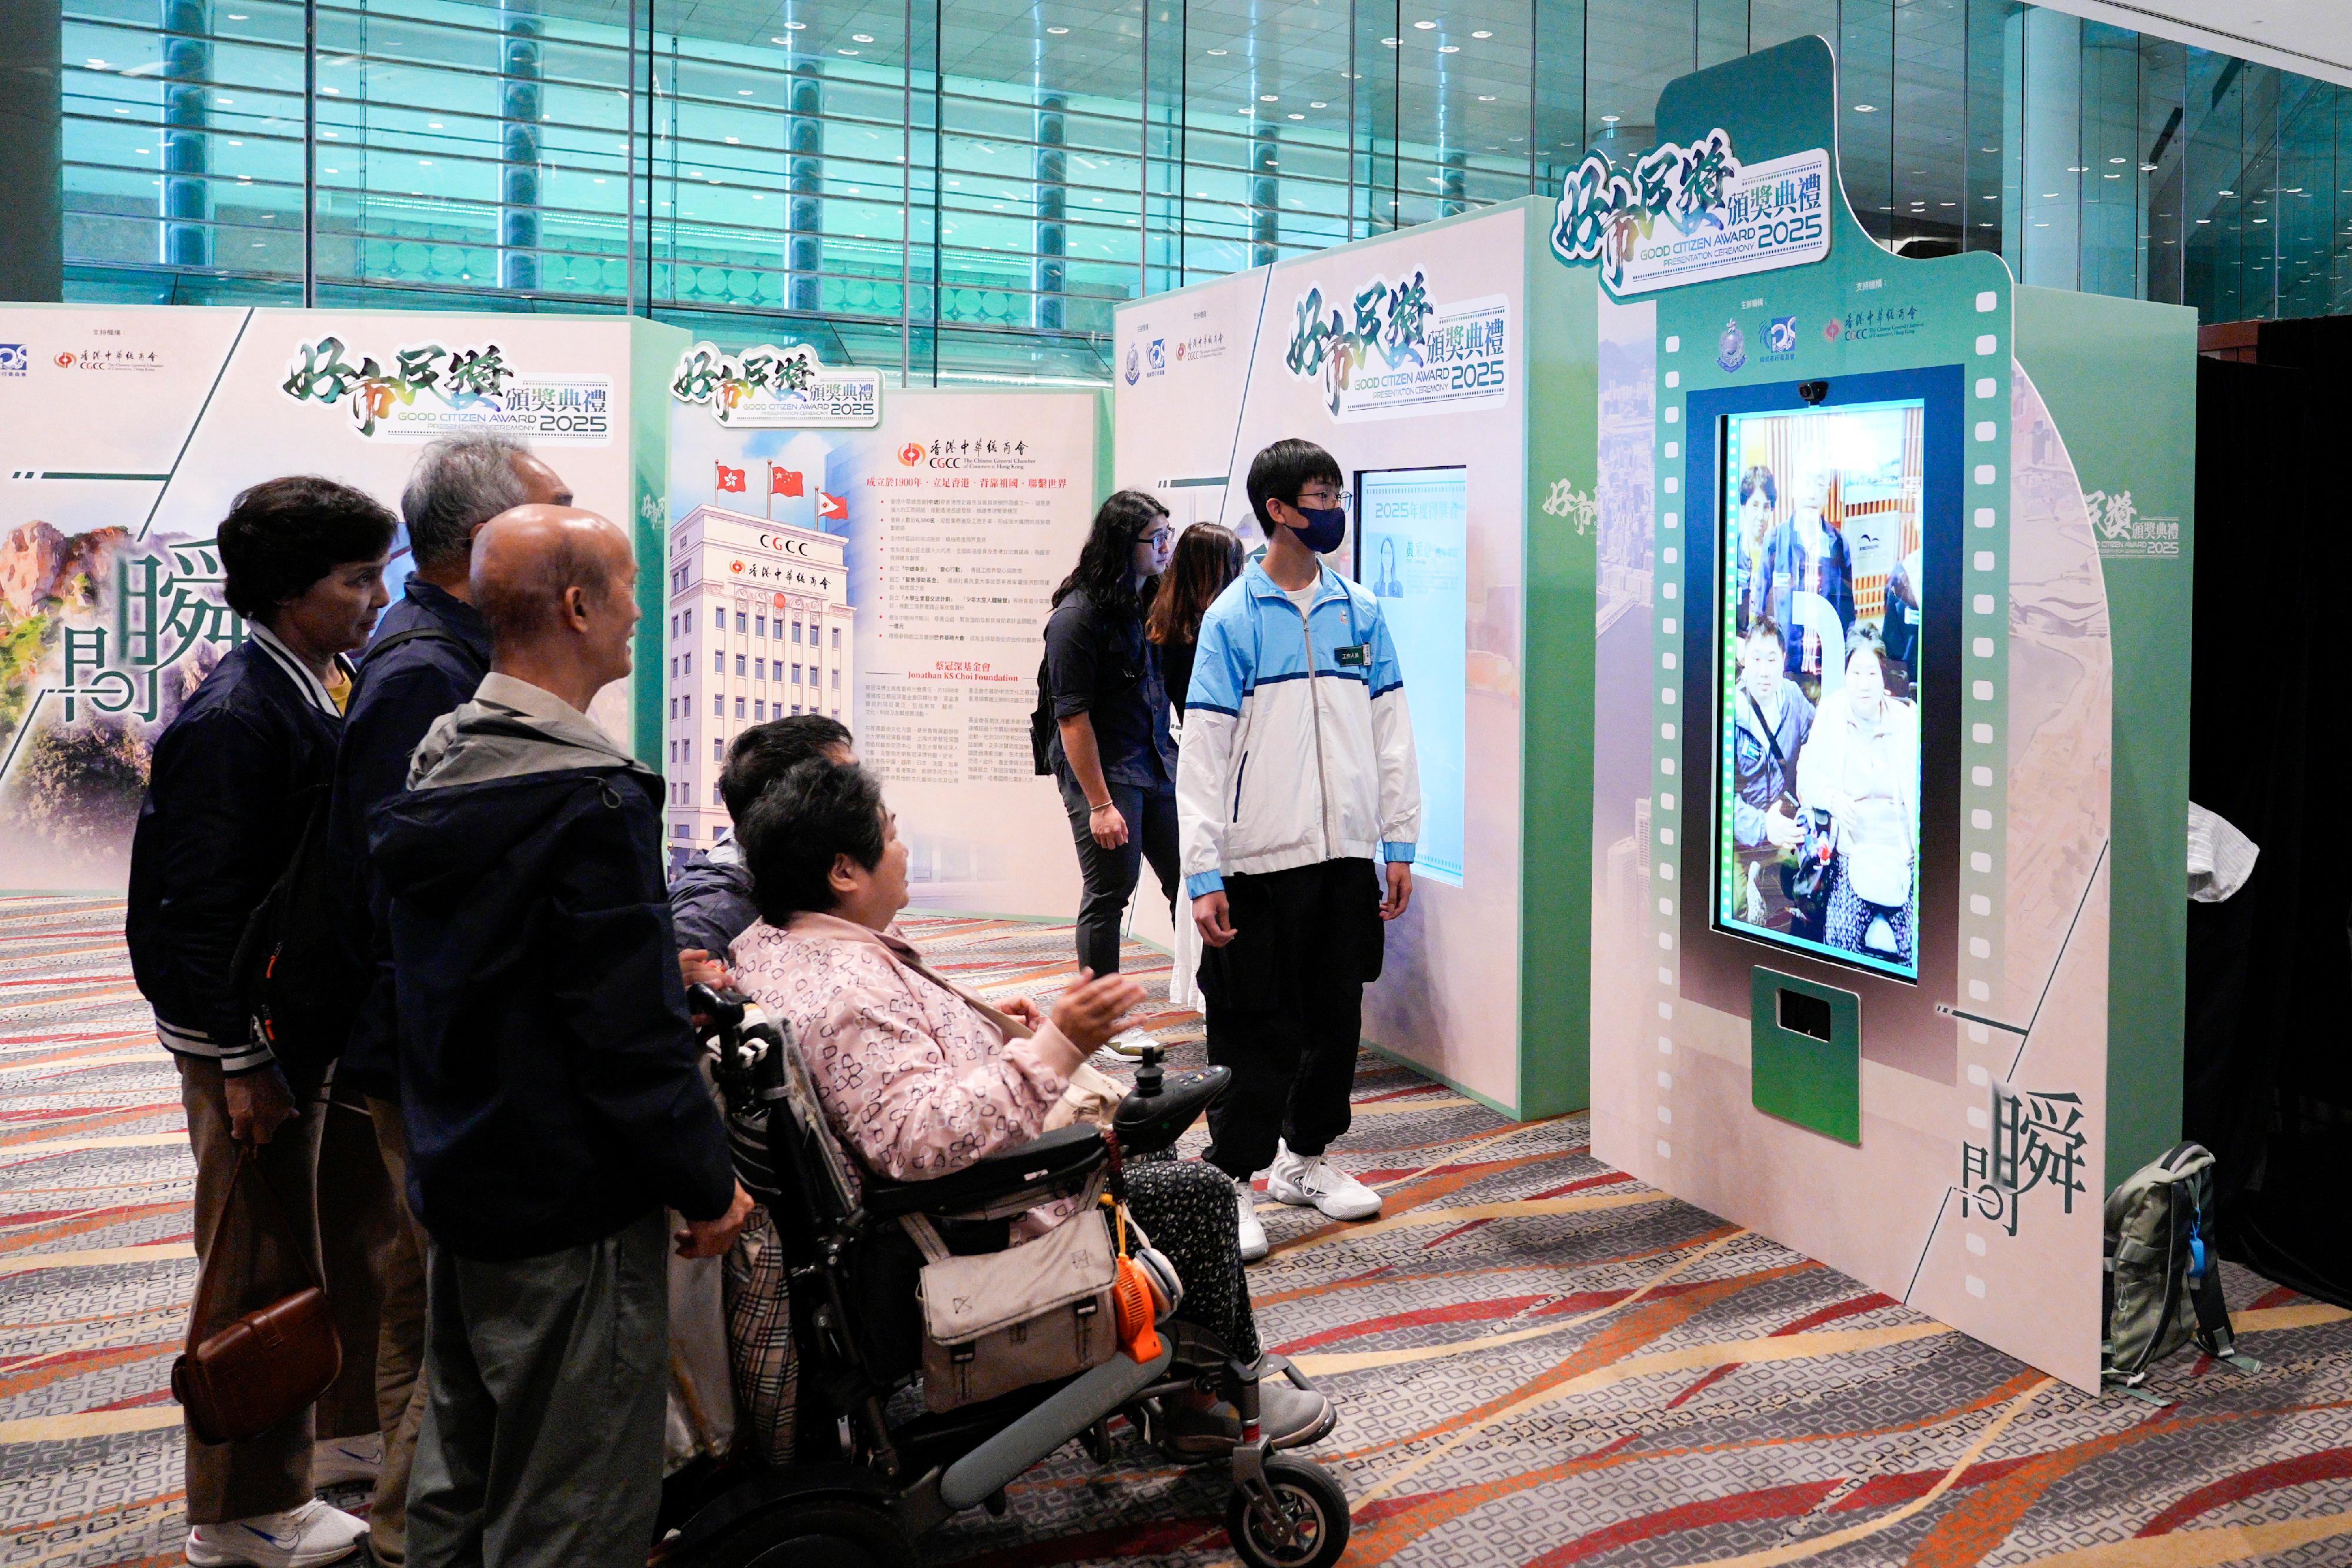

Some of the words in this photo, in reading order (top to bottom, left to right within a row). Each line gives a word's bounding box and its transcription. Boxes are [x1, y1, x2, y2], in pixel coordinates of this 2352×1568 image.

[1727, 173, 1821, 226] 頒獎典禮
[1758, 213, 1822, 249] 2025
[1641, 245, 1671, 260] GOOD
[1673, 236, 1712, 255] CITIZEN
[1714, 227, 1756, 247] AWARD
[1663, 251, 1713, 267] PRESENTATION
[1715, 242, 1755, 258] CEREMONY
[1426, 318, 1504, 364] 頒獎典禮
[1845, 329, 1867, 340] CGCC
[80, 362, 105, 370] CGCC
[1452, 360, 1504, 389] 2025
[1355, 376, 1379, 390] GOOD
[1381, 372, 1413, 387] CITIZEN
[1415, 367, 1449, 383] AWARD
[505, 388, 607, 413] 頒獎典禮
[810, 383, 874, 402] 頒獎典禮
[1373, 387, 1414, 399] PRESENTATION
[1415, 383, 1448, 394] CEREMONY
[398, 412, 436, 421] GOOD
[440, 413, 486, 422] CITIZEN
[489, 414, 537, 423] AWARD
[830, 403, 874, 415] 2025
[540, 415, 607, 432] 2025
[929, 457, 961, 469] CGCC
[1542, 478, 1598, 536] 好市
[760, 534, 808, 557] CGCC
[2147, 541, 2179, 554] 2025
[936, 661, 991, 672] 蔡冠深基金會
[908, 671, 942, 680] Jonathan
[955, 673, 973, 681] Choi
[974, 673, 1018, 682] Foundation
